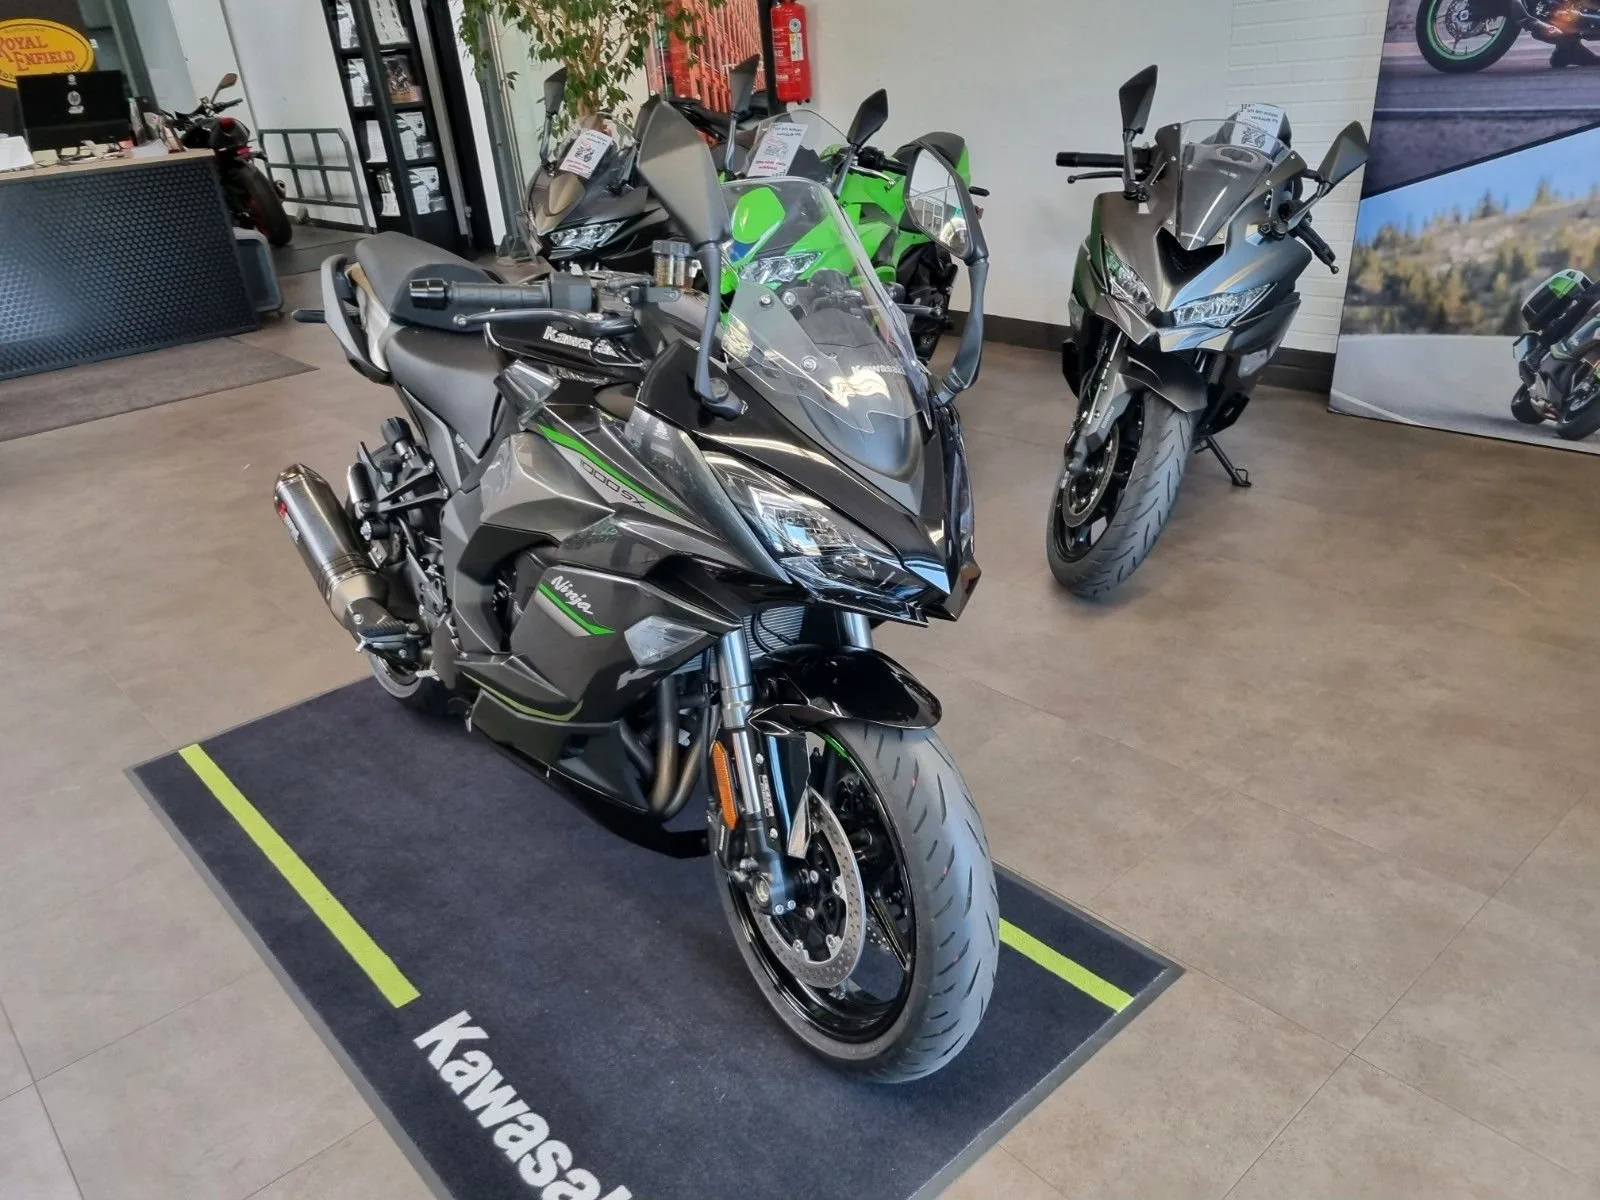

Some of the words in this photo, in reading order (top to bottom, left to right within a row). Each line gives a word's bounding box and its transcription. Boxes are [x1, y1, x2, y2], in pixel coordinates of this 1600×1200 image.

[12, 50, 76, 71] ENFIELD
[551, 575, 594, 615] Ninja
[412, 1009, 633, 1200] Kawasa
